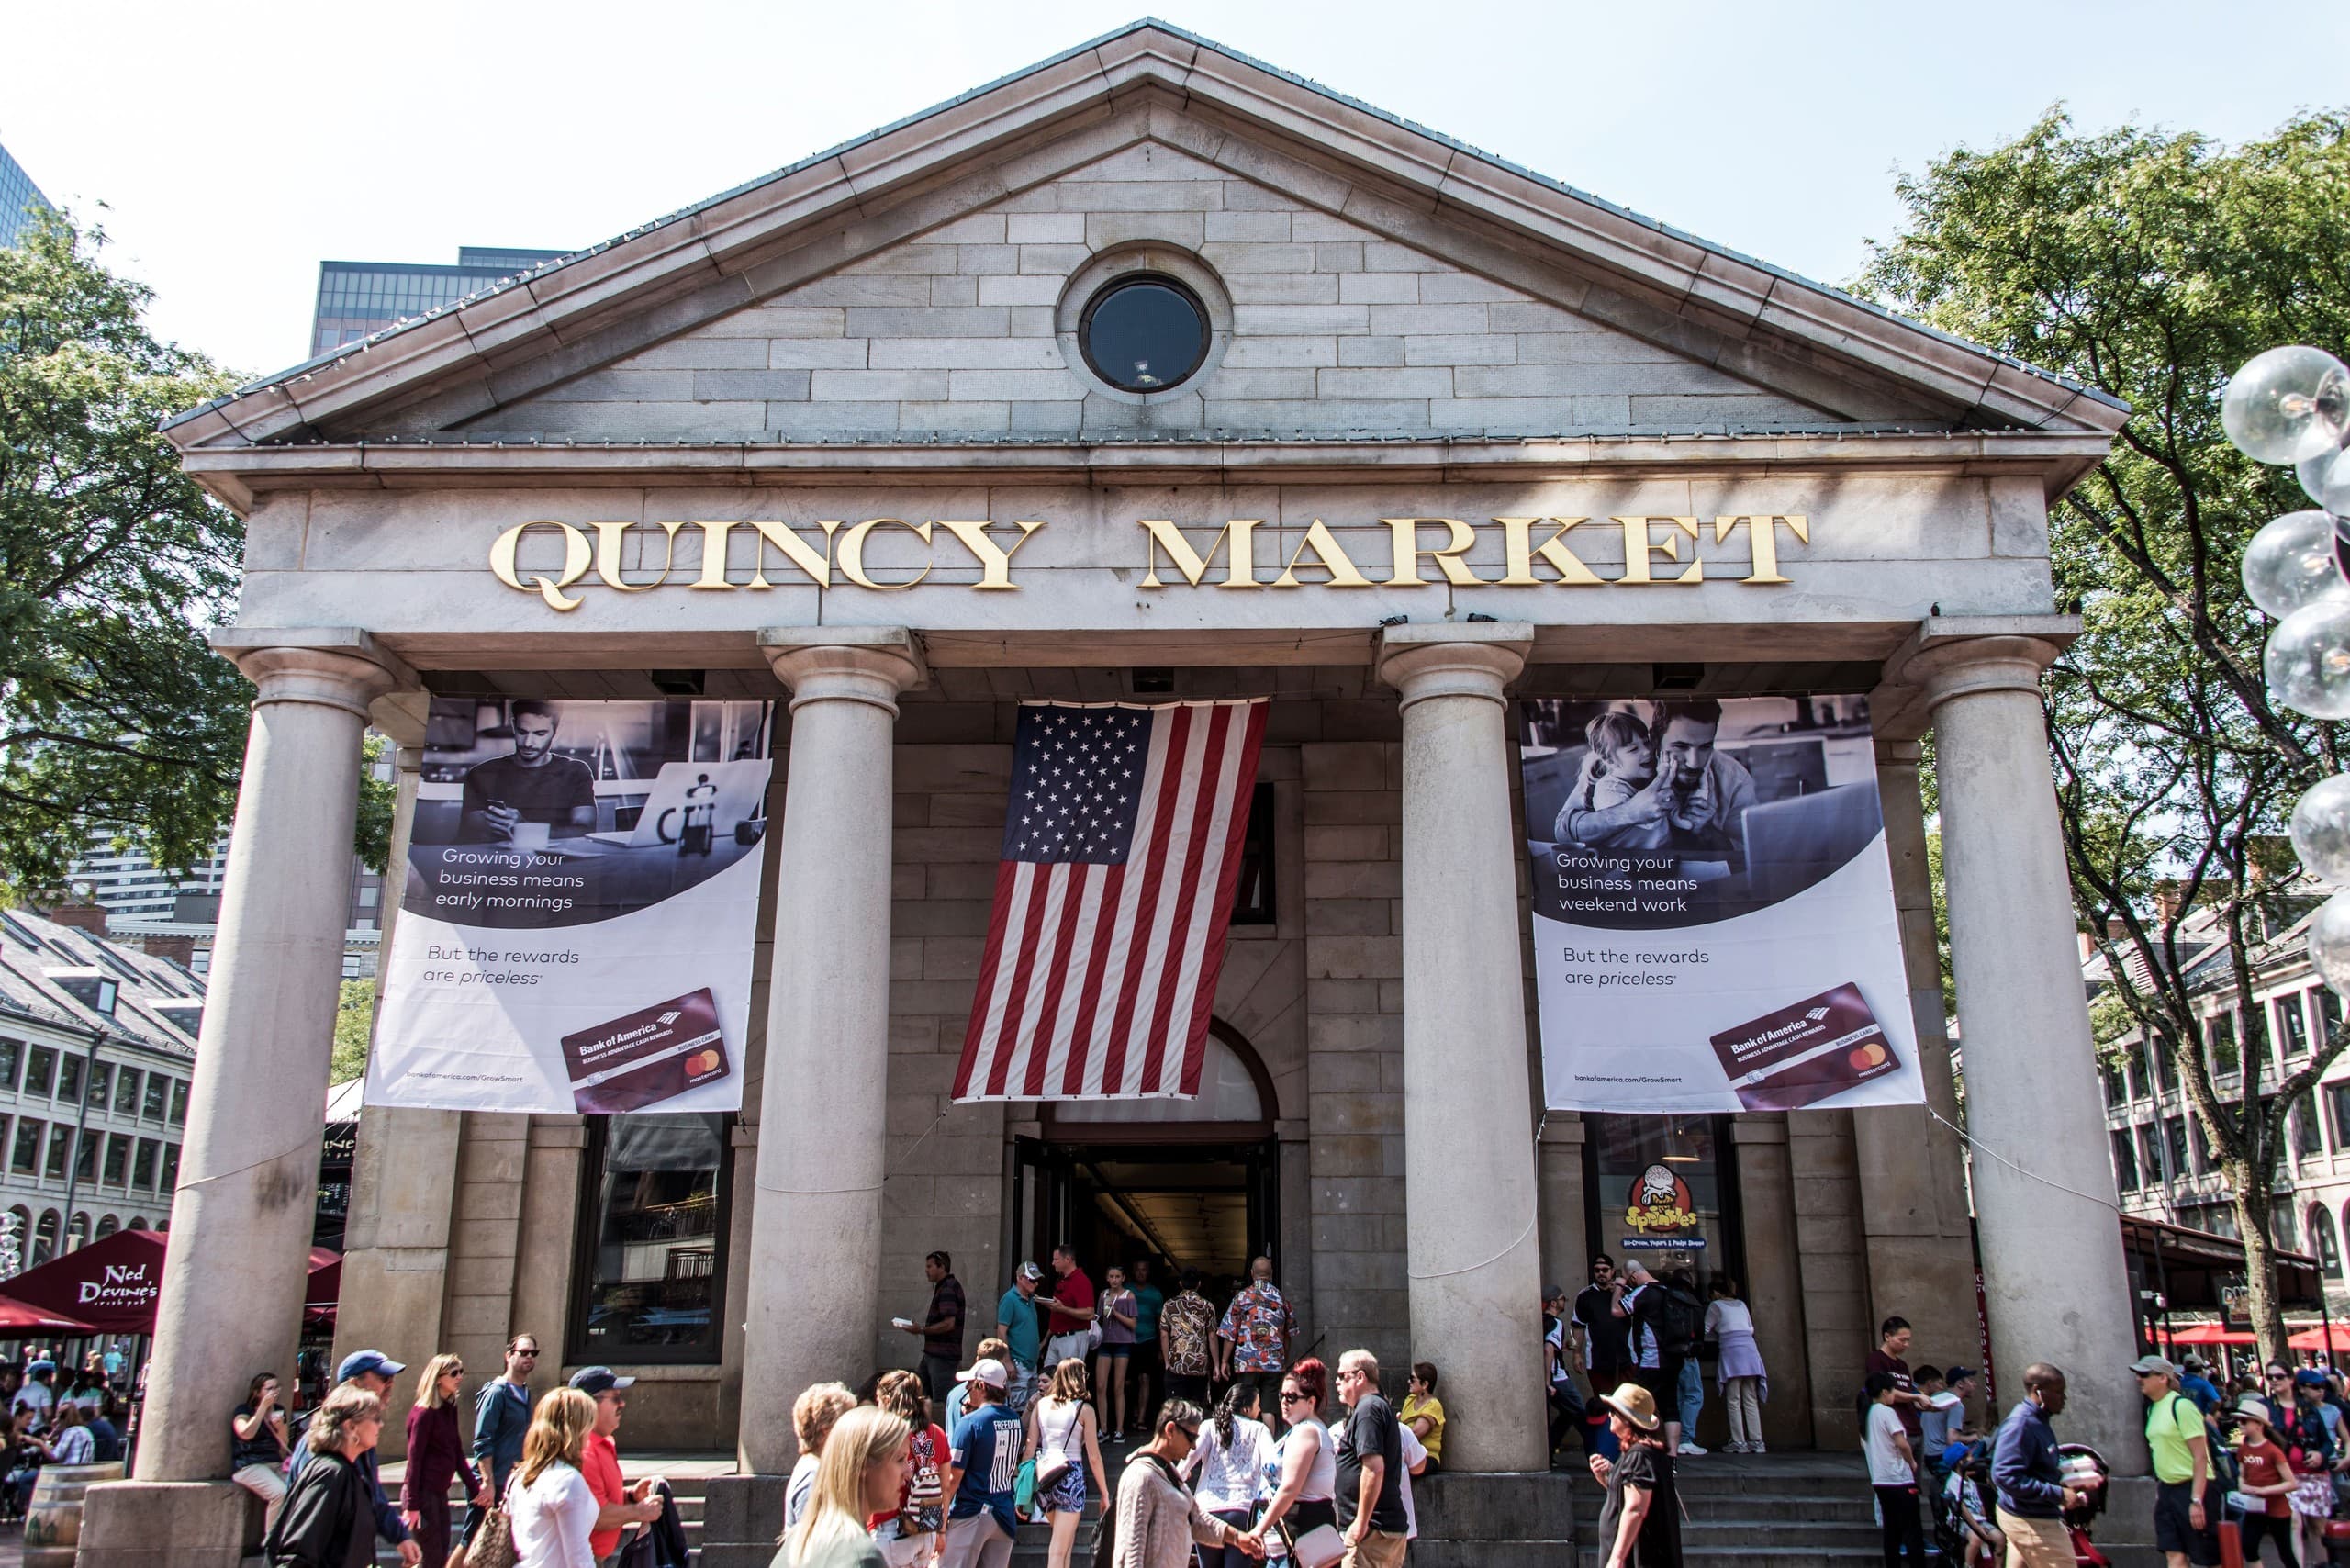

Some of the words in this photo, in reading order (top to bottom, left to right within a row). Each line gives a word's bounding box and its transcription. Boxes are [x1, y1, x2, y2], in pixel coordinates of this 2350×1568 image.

[489, 518, 1048, 611] QUINCY
[1136, 517, 1808, 588] MARKET
[442, 848, 521, 868] Growing
[526, 854, 565, 868] your
[1557, 853, 1630, 872] Growing
[1634, 858, 1674, 872] your
[439, 869, 518, 886] business
[523, 876, 585, 887] means
[1559, 875, 1632, 890] business
[1638, 879, 1697, 890] means
[436, 892, 483, 910] early
[487, 894, 573, 912] mornings
[1559, 897, 1637, 912] weekend
[1642, 897, 1687, 912] work
[428, 946, 462, 960] But
[468, 947, 498, 962] the
[504, 949, 579, 963] rewards
[1563, 947, 1595, 963] But
[1600, 948, 1629, 963] the
[1636, 949, 1709, 963] rewards
[424, 970, 454, 982] are
[1565, 973, 1594, 984] are
[579, 1041, 606, 1056] Bank
[606, 1035, 616, 1047] of
[617, 1023, 657, 1044] America
[1730, 1037, 1758, 1055] Bank
[1757, 1032, 1767, 1046] of
[1767, 1020, 1807, 1041] America
[689, 1068, 722, 1083] mastercard
[1575, 1074, 1682, 1083] bankofamerica.com/GrowSmart
[1858, 1061, 1891, 1079] mastercard
[1625, 1206, 1697, 1234] Sprinkles
[103, 1264, 147, 1287] Ned
[993, 1418, 1021, 1430] FREEDOM
